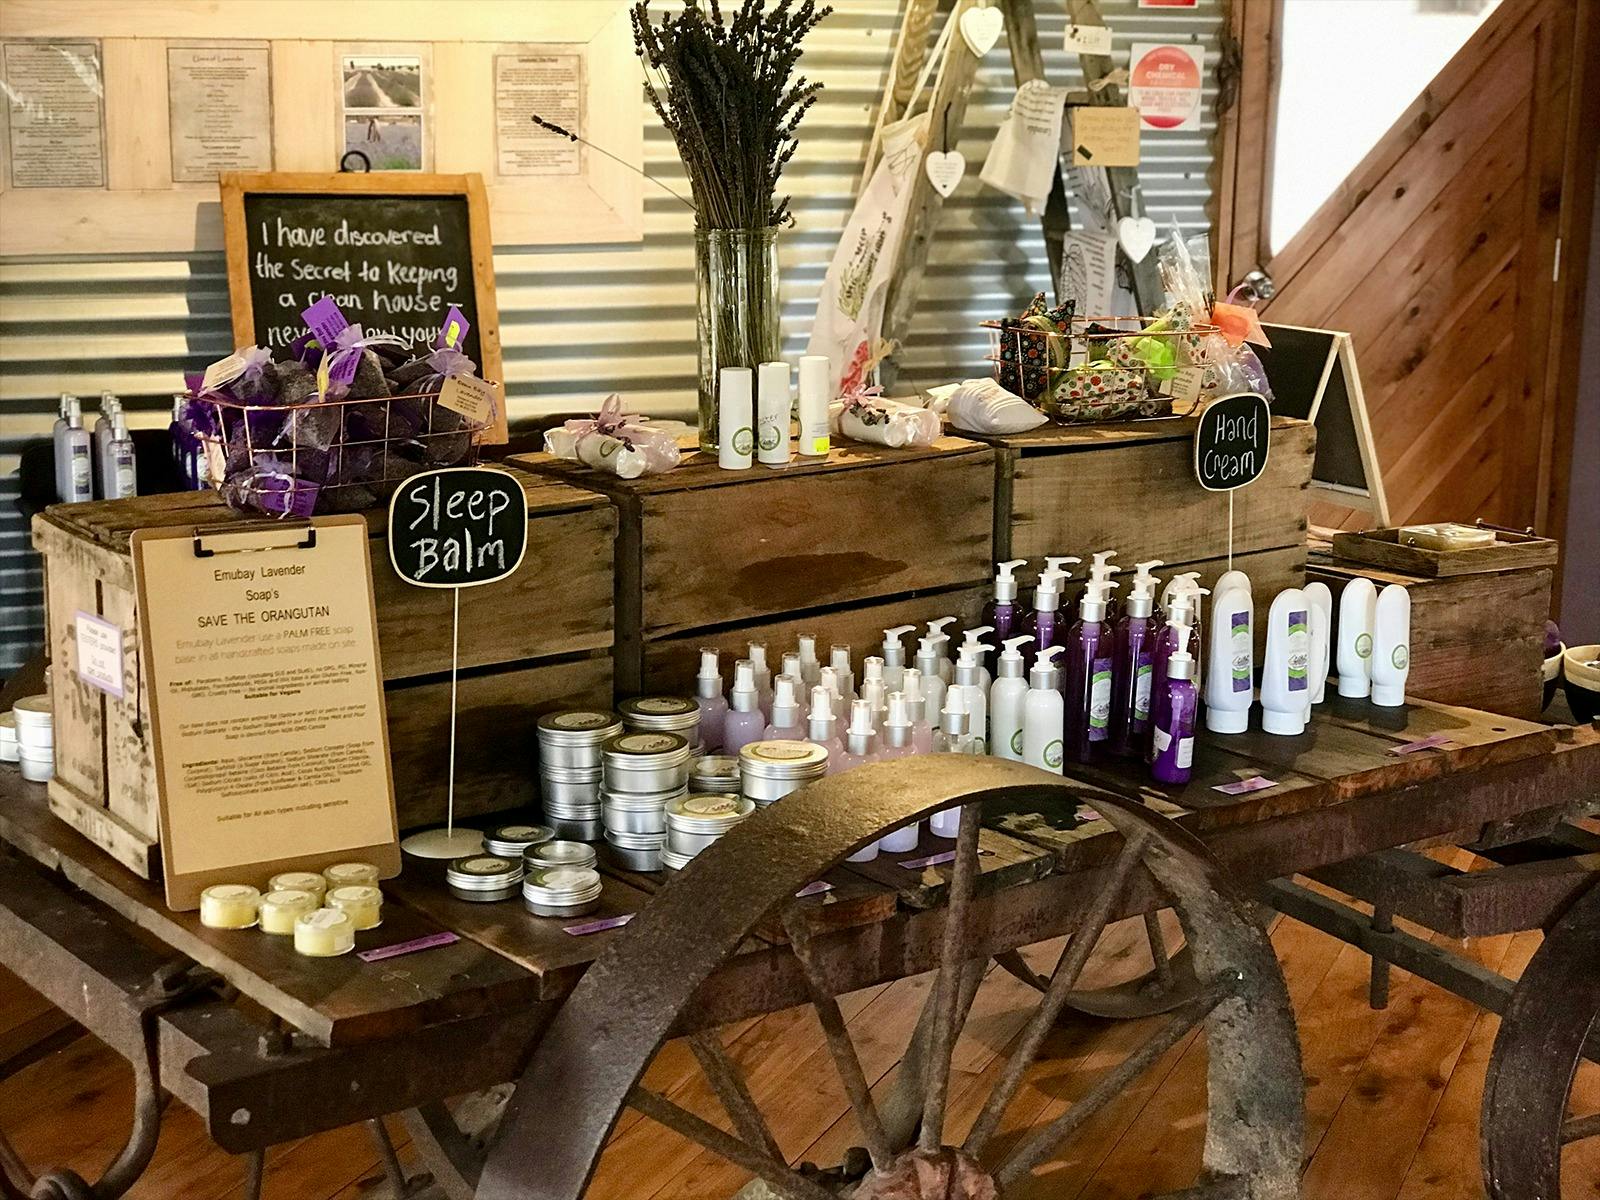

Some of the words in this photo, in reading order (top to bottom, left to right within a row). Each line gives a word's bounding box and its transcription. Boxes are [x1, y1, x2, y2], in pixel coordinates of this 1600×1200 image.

[262, 221, 268, 246] I
[277, 216, 326, 247] have
[334, 218, 442, 246] discovered
[256, 250, 285, 279] the
[358, 260, 380, 282] to
[279, 292, 296, 308] a
[373, 290, 442, 314] house
[1215, 405, 1258, 448] Hand
[1204, 449, 1254, 480] Cream
[409, 476, 510, 536] Sleep
[410, 527, 505, 580] Balm
[214, 568, 255, 582] Emubay
[261, 564, 306, 578] Lavender
[246, 588, 279, 601] Soap's
[198, 614, 228, 628] SAVE
[233, 612, 255, 624] THE
[261, 605, 330, 623] ORANGUTAN
[176, 638, 213, 650] Emubay
[215, 634, 257, 646] Lavender
[259, 633, 274, 642] use
[283, 628, 308, 639] PALM
[310, 626, 331, 637] FREE
[333, 625, 354, 636] soap
[175, 654, 196, 665] base
[199, 654, 207, 662] in
[220, 646, 274, 660] handcrafted
[277, 644, 301, 656] soaps
[302, 642, 327, 652] made
[329, 641, 340, 649] on
